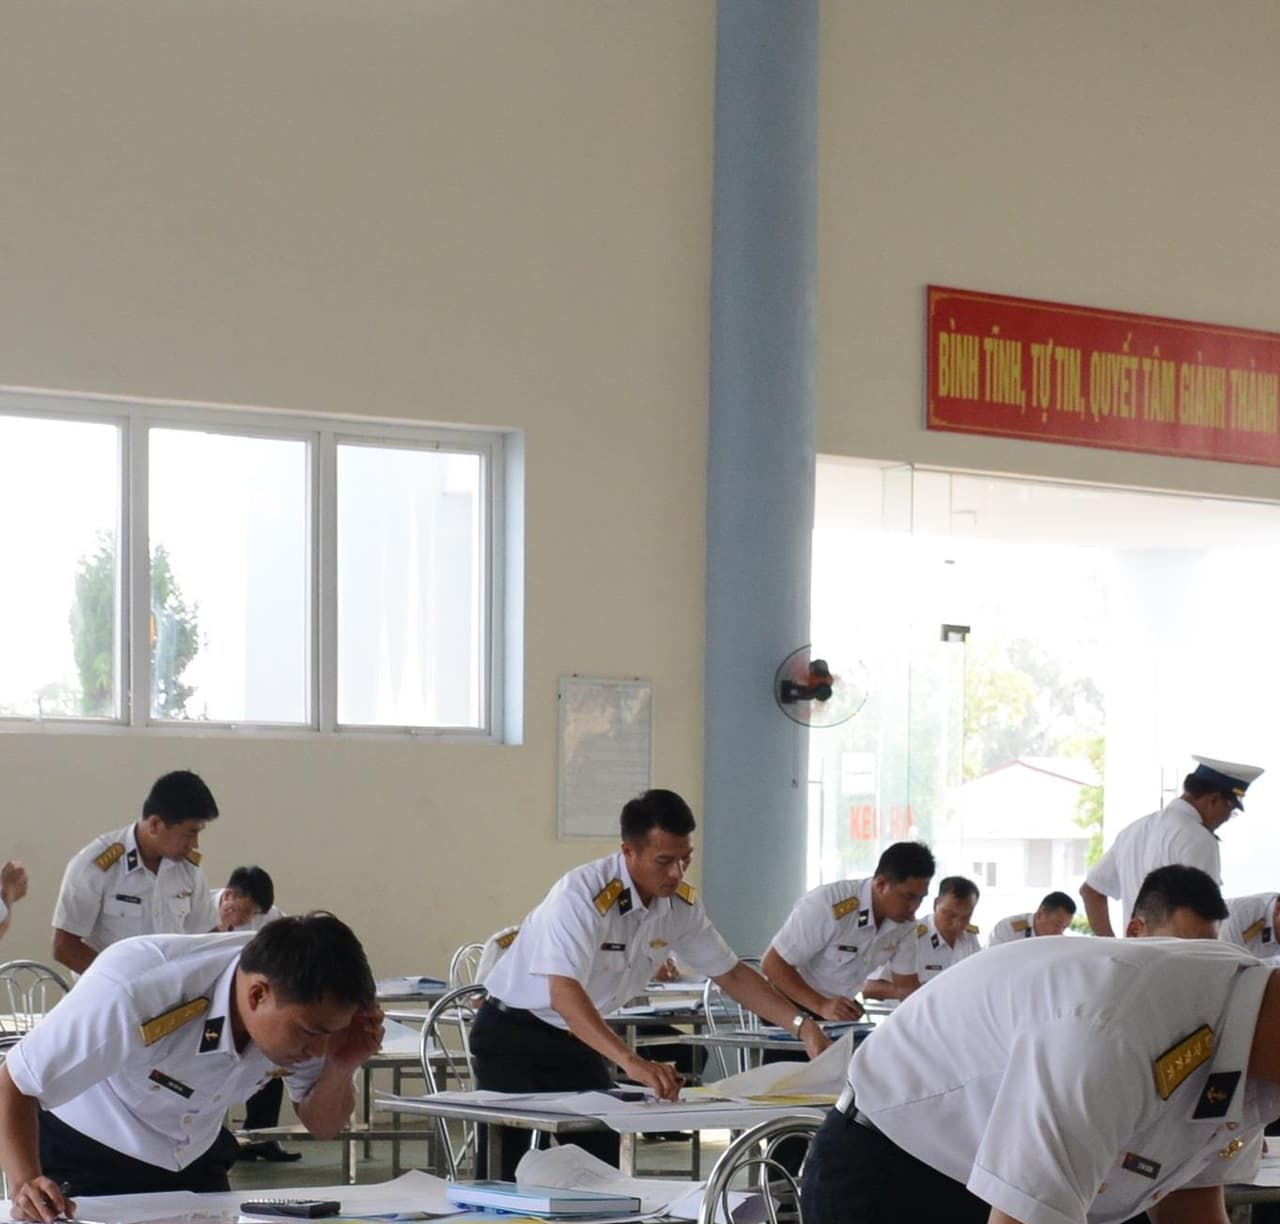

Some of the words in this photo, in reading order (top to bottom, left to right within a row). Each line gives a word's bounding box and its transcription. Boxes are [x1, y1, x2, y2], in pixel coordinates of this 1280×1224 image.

[938, 318, 979, 401] BÌNH
[1030, 338, 1053, 424] TỰ
[1090, 331, 1139, 423] QUYẾT
[1142, 345, 1175, 423] TÂM
